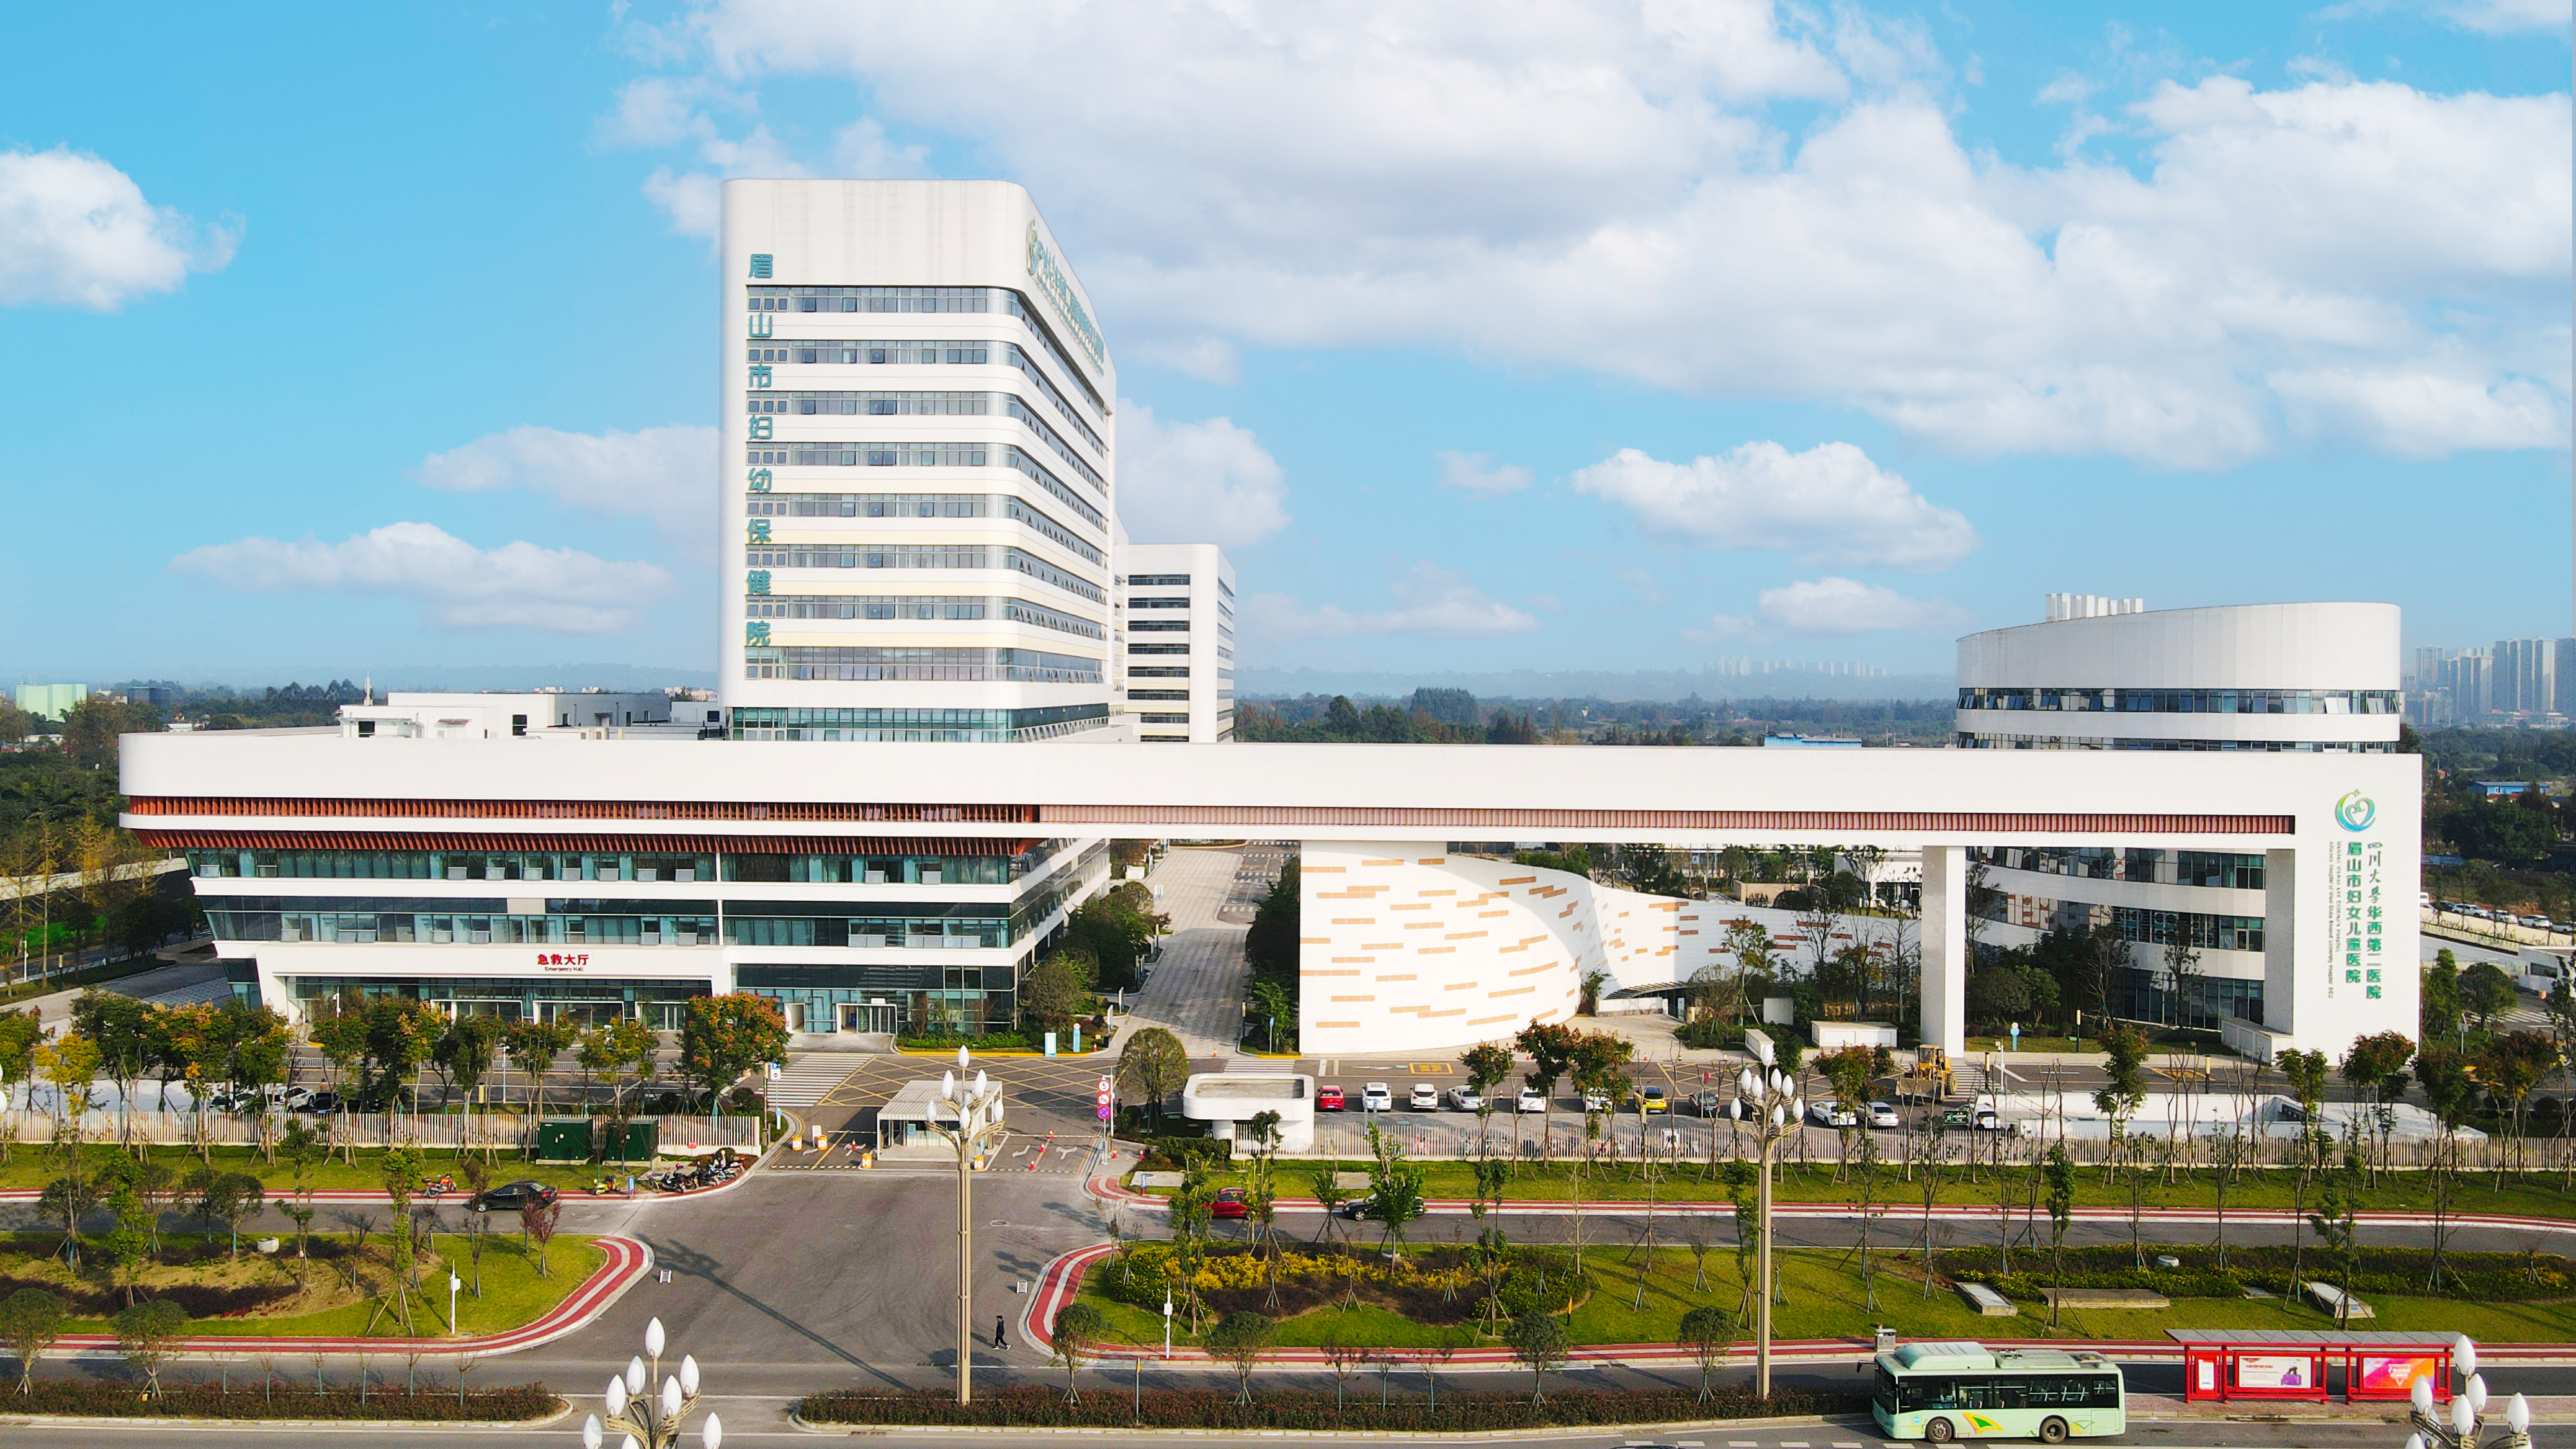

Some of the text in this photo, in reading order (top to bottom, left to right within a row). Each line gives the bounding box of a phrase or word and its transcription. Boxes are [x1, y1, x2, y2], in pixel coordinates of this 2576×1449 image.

[746, 253, 773, 647] 眉山市妇幼保健院
[537, 954, 589, 965] 急救大厅
[2346, 842, 2362, 983] 眉山市妇女儿童医院
